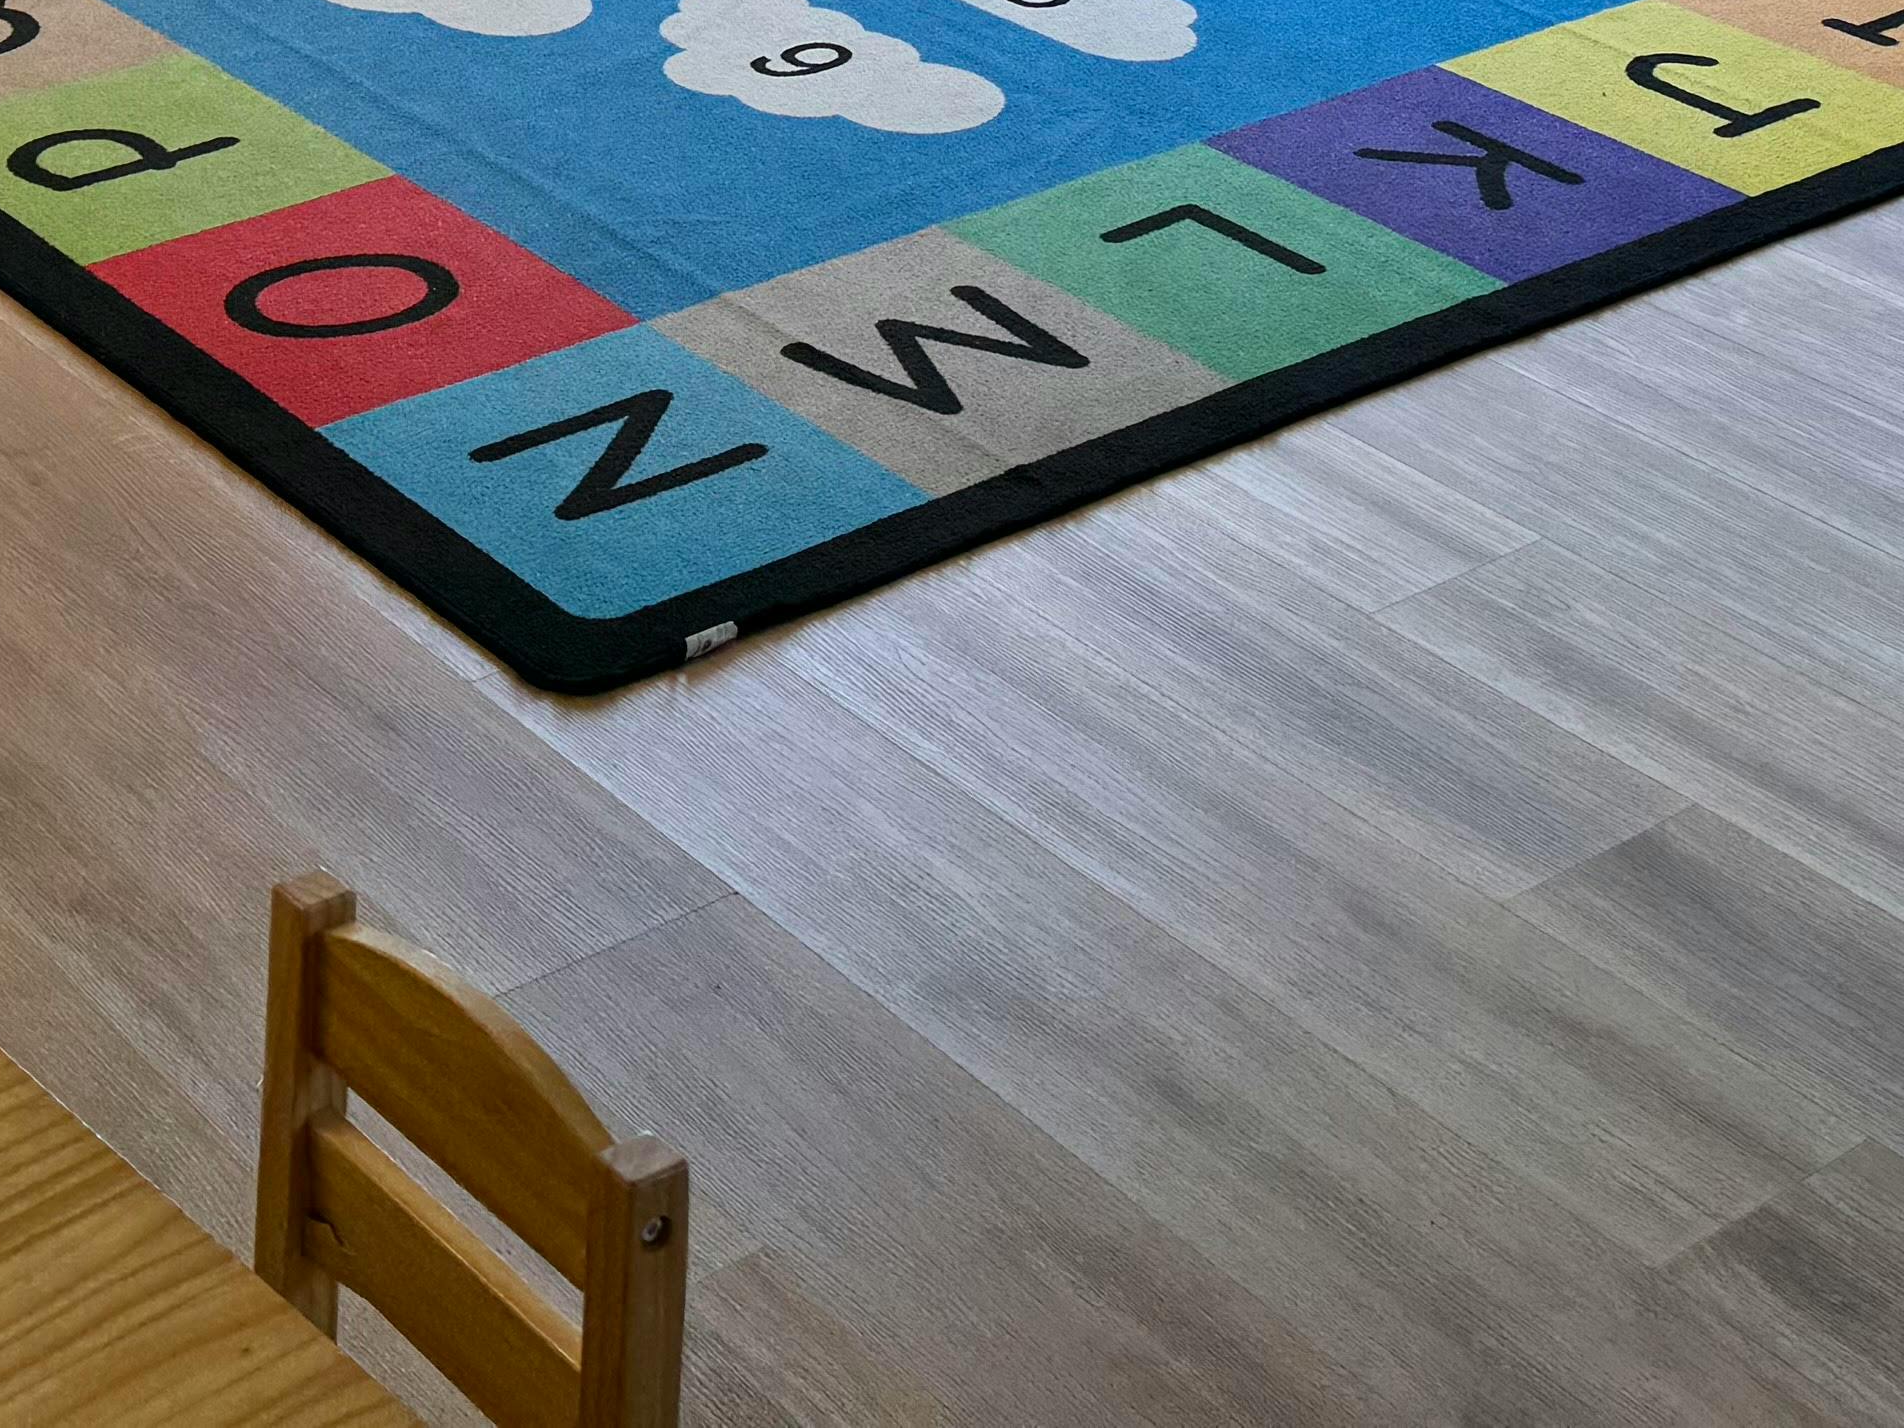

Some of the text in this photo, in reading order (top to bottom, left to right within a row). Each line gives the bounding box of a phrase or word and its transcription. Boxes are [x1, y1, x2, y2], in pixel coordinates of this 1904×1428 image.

[1624, 52, 1822, 139] J
[6, 127, 241, 192] P
[1353, 119, 1585, 211] K
[1098, 203, 1327, 275] L
[222, 252, 461, 339] O
[779, 284, 1091, 417] M
[467, 388, 770, 521] N
